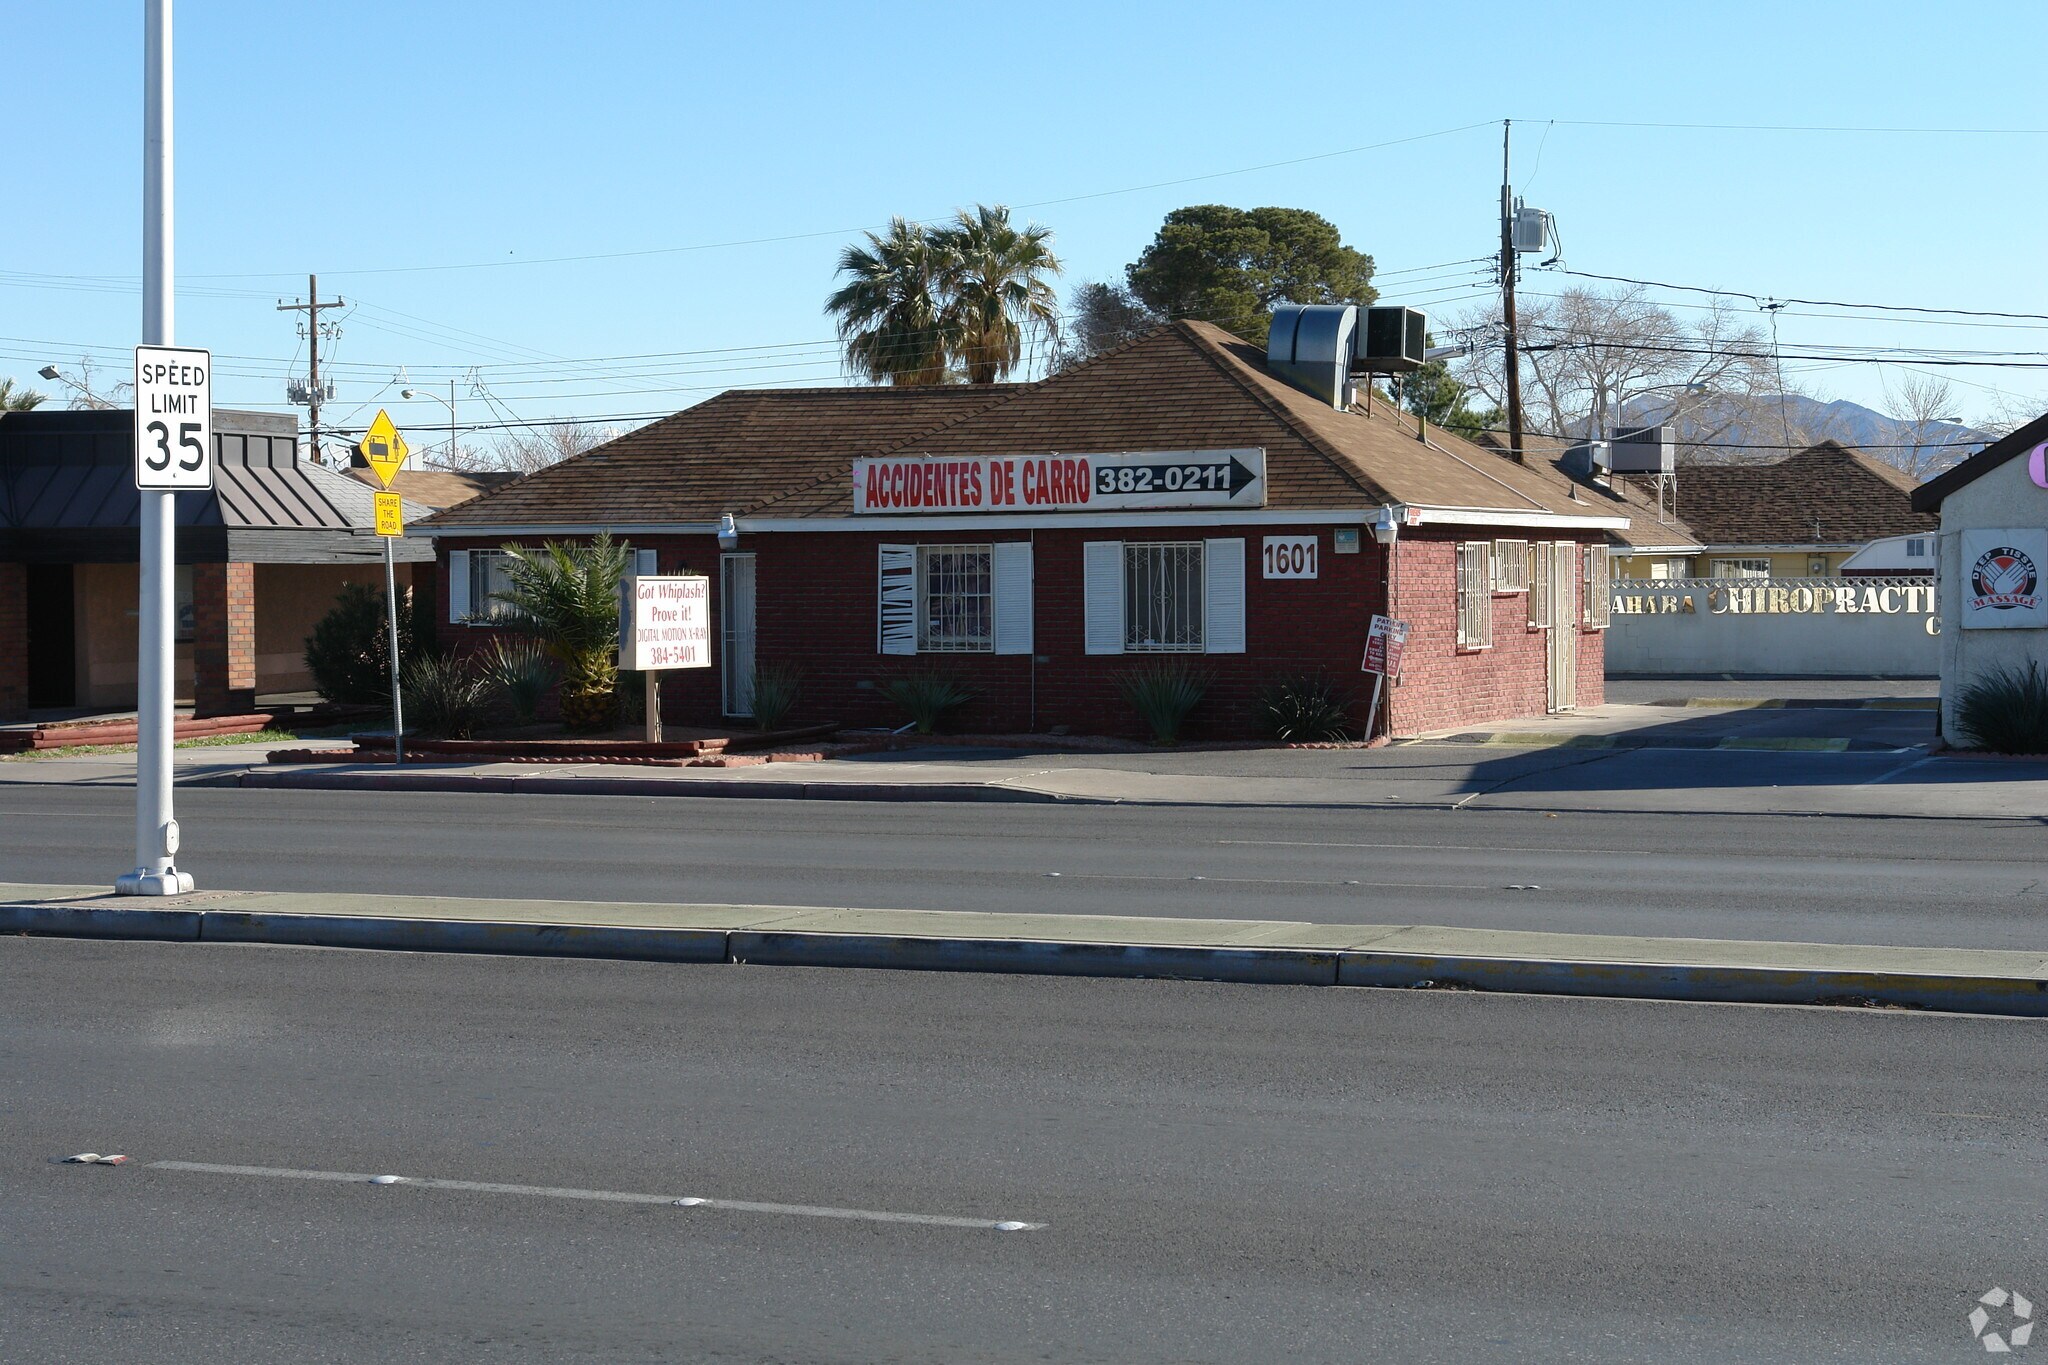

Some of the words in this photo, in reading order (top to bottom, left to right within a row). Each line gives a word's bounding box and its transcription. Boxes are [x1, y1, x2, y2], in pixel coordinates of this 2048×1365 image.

[142, 363, 205, 386] SPEED
[151, 393, 198, 414] LIMIT
[145, 420, 204, 471] 35
[865, 461, 983, 508] ACCIDENTES
[990, 460, 1016, 506] DE
[1022, 458, 1091, 505] CARRO
[1099, 465, 1231, 493] 382-0211
[378, 497, 398, 508] SHARE
[382, 509, 394, 519] THE
[381, 520, 397, 530] ROAD
[1264, 543, 1315, 574] 1601
[1972, 551, 1992, 580] DEEP
[2001, 547, 2037, 579] TISSUE
[638, 583, 655, 600] Got
[658, 583, 706, 603] Whiplash?
[1973, 595, 2037, 609] MASSAGE
[651, 606, 678, 622] Prove
[681, 605, 692, 621] it!
[1605, 595, 1697, 614] AHARA
[1374, 623, 1404, 636] PARKING
[1376, 617, 1404, 628] PATIENT
[638, 628, 660, 642] DIGITAL
[661, 627, 687, 641] MOTION
[650, 645, 696, 665] 384-5401
